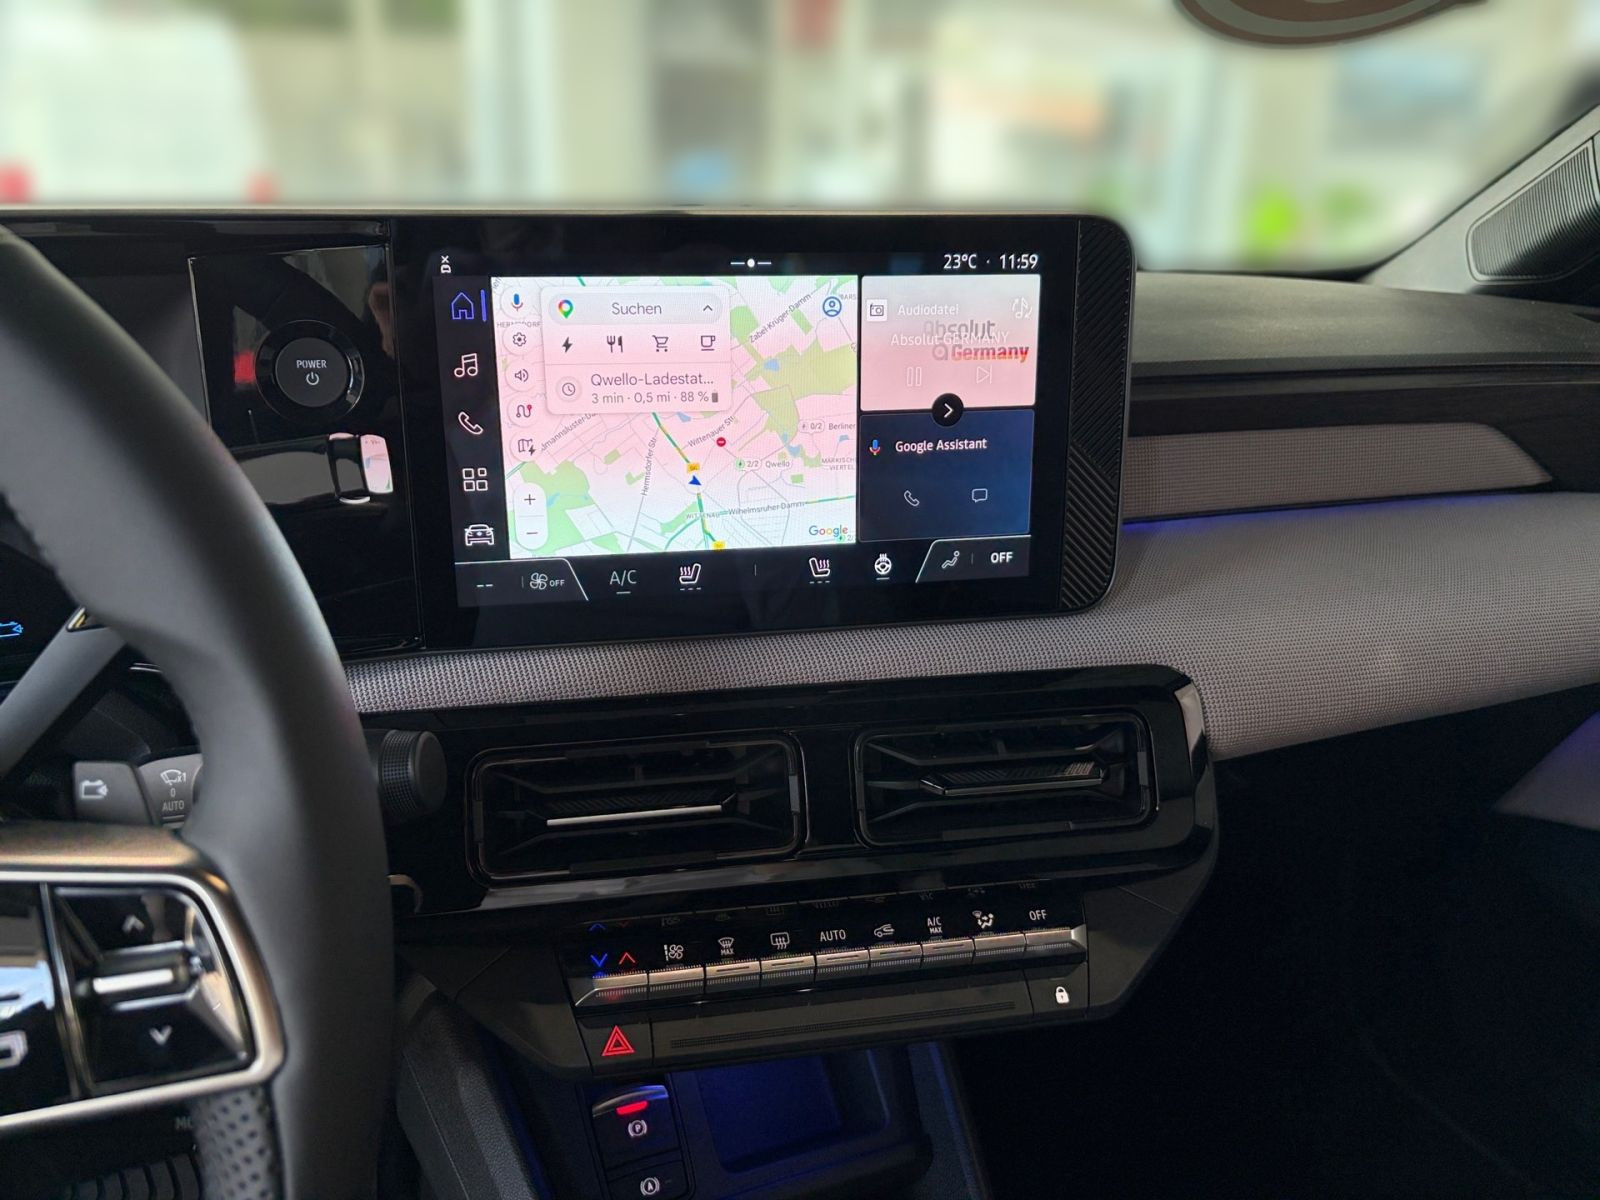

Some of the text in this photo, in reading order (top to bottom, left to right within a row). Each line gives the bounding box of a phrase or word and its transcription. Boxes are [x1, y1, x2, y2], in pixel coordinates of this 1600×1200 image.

[943, 254, 1039, 269] 23°C 11:59
[611, 302, 662, 315] Suchen
[897, 303, 959, 316] Audiodatei
[890, 331, 1009, 346] Absolut GERMANY
[951, 343, 1030, 363] Germany
[296, 359, 327, 369] POWER
[590, 372, 714, 387] Qwello-Ladestat...
[591, 391, 709, 404] 3 min 0,5 mi 88 %
[809, 422, 823, 430] 0/2
[828, 422, 856, 431] Berliner
[895, 438, 988, 454] Google Assistant
[746, 460, 759, 469] 2/2
[765, 460, 790, 469] Qwello
[781, 501, 805, 510] Damm
[808, 524, 848, 537] Google
[990, 551, 1013, 563] OFF
[549, 579, 565, 587] OFF
[609, 570, 637, 586] A/C
[162, 801, 185, 812] AUTO
[1028, 909, 1048, 921] OFF
[927, 916, 942, 927] A/C
[819, 929, 846, 942] AUTO
[720, 947, 734, 956] MAX
